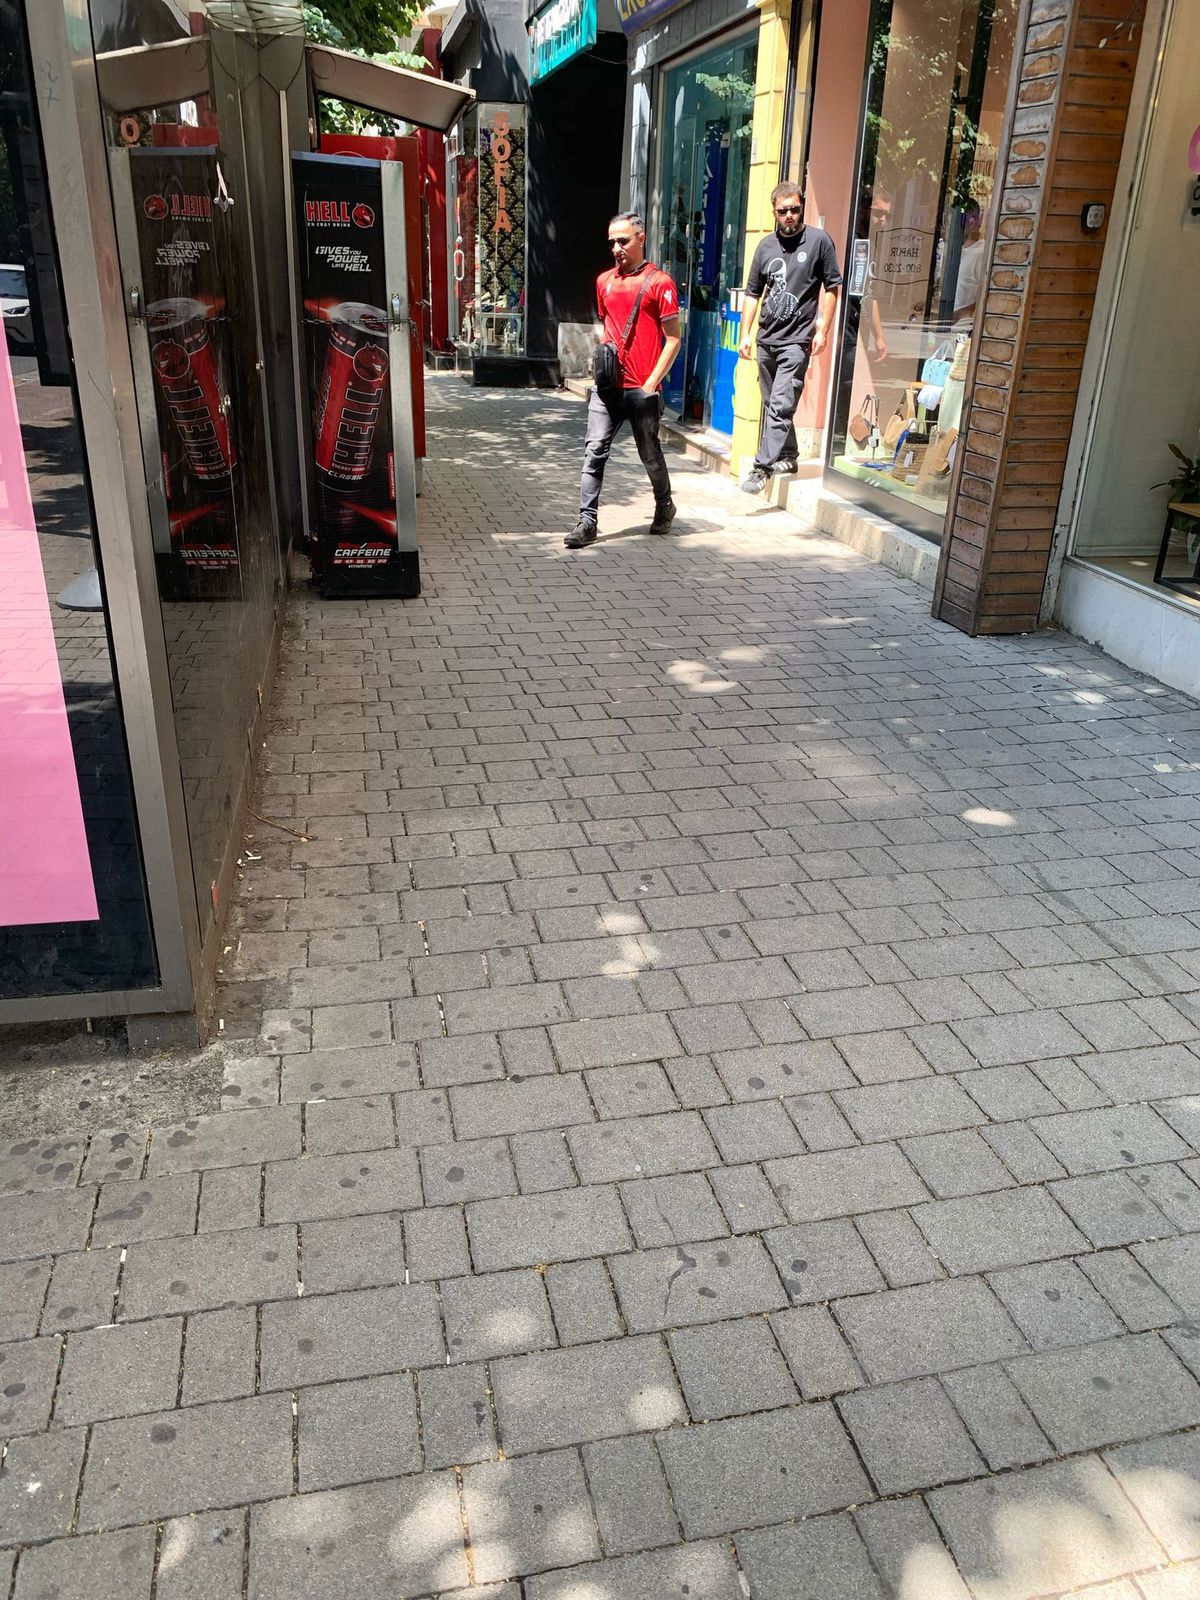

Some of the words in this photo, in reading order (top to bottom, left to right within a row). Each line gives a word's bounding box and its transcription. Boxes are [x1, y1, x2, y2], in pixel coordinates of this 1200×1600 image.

[492, 111, 512, 233] SOFIA
[306, 201, 350, 222] HELL
[315, 246, 350, 255] GIVES
[327, 254, 368, 264] POWER
[344, 263, 372, 272] HELL
[333, 388, 383, 467] HELL
[334, 549, 392, 557] CAFFEINE
